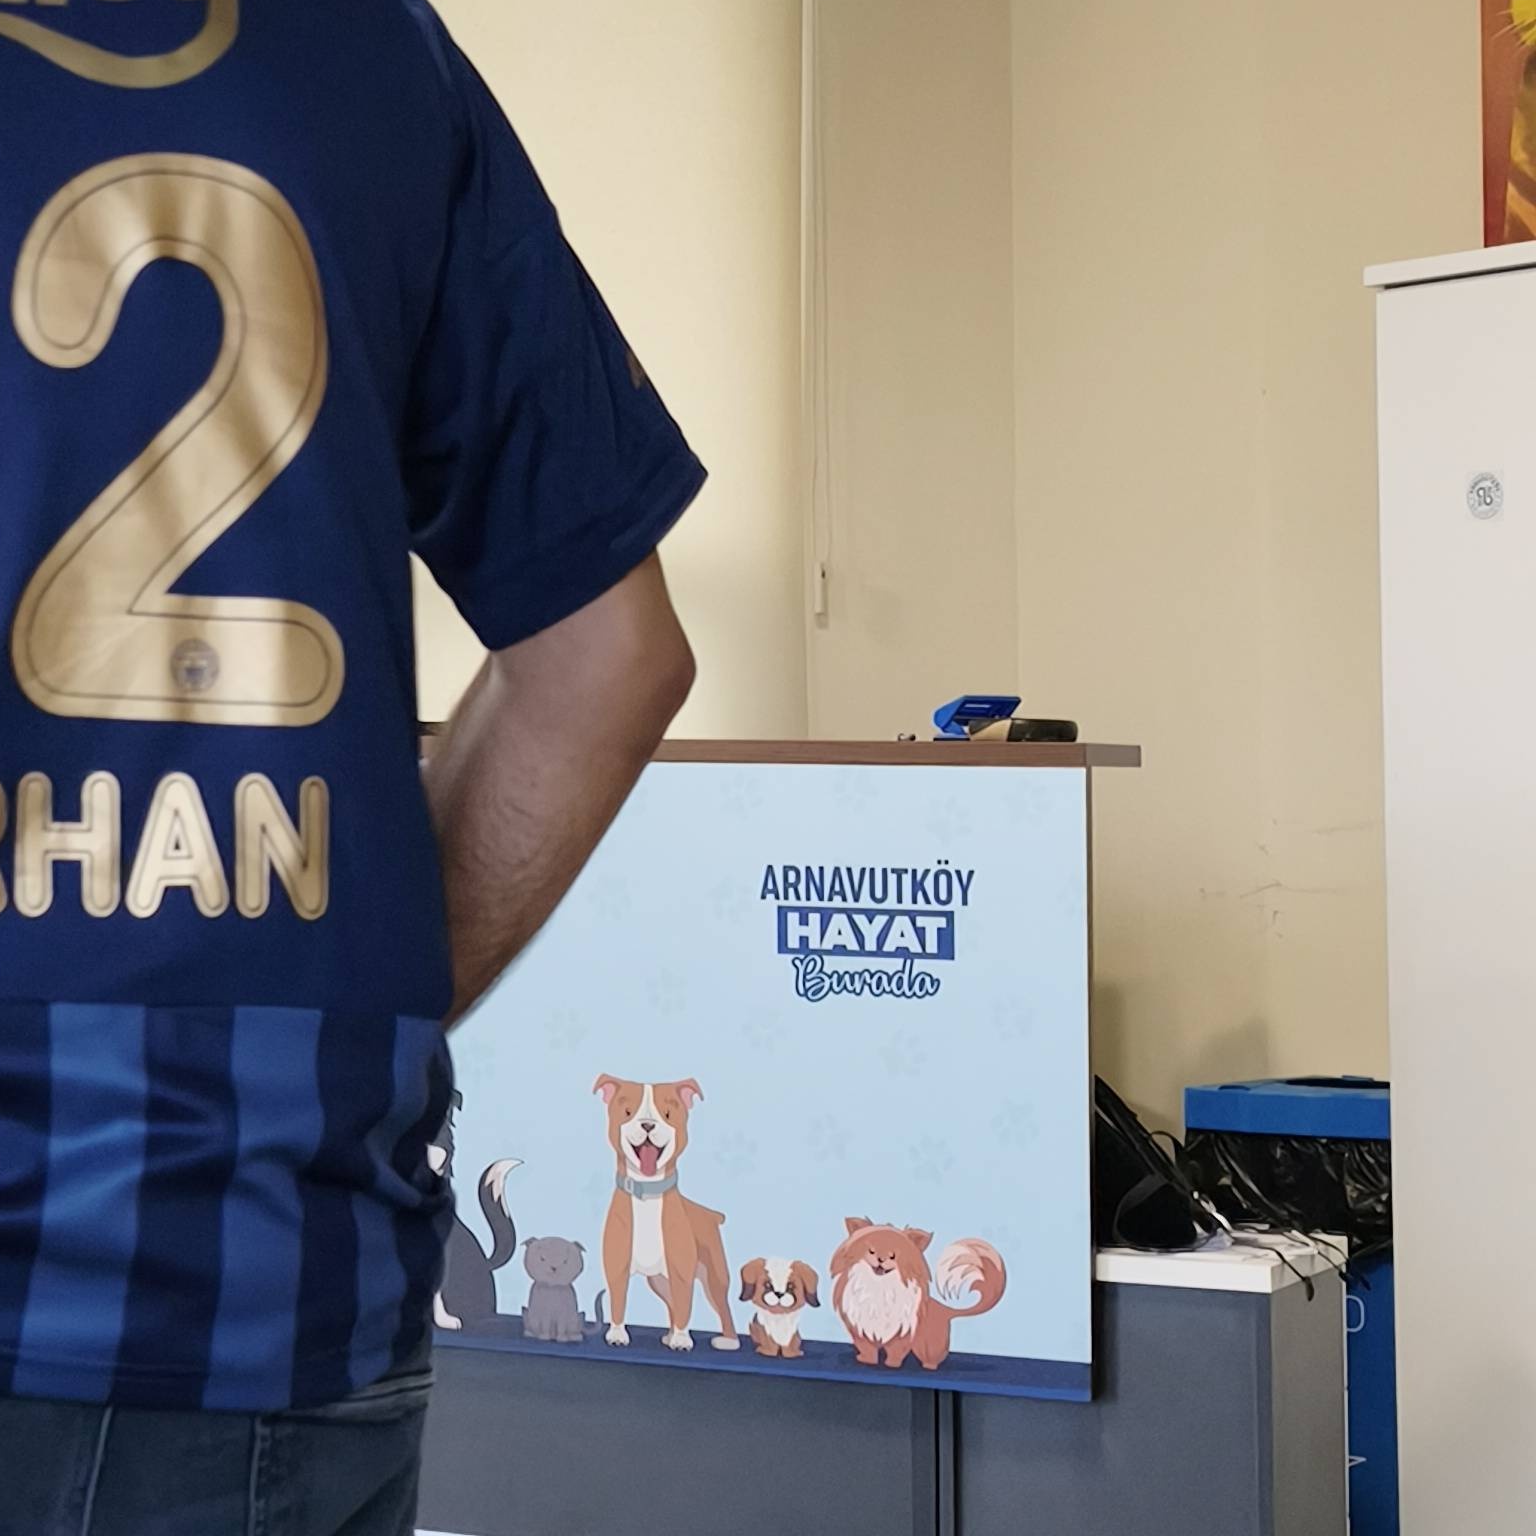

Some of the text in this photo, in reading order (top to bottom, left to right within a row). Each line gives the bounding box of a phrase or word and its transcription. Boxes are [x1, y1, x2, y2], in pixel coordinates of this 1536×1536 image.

[760, 859, 975, 907] ARNAVUTKÖY
[785, 911, 948, 954] HAYAT
[793, 954, 941, 1002] Burada
